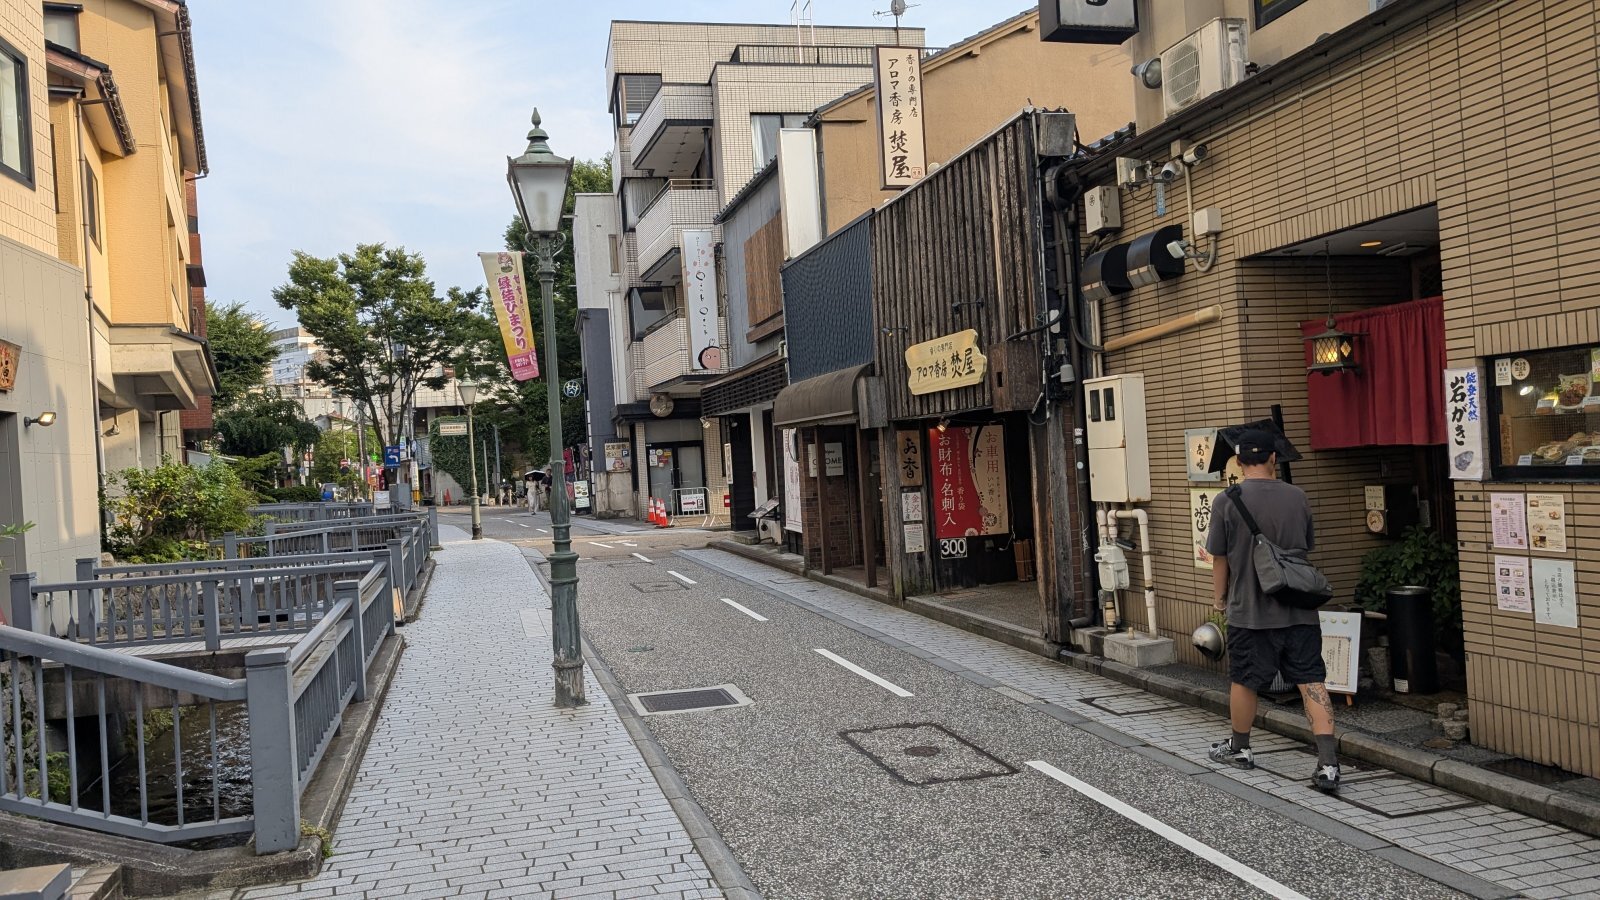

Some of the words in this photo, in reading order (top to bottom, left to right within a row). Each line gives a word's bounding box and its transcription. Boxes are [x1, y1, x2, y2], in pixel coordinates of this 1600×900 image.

[888, 58, 904, 125] アロマ香房
[906, 54, 918, 118] 香りの専門店
[497, 276, 527, 350] 縁結びまつり
[1450, 376, 1467, 446] 岩がき
[1465, 372, 1478, 422] 能登天然
[902, 437, 919, 479] お香
[985, 432, 998, 473] お車用
[941, 540, 966, 555] 300
